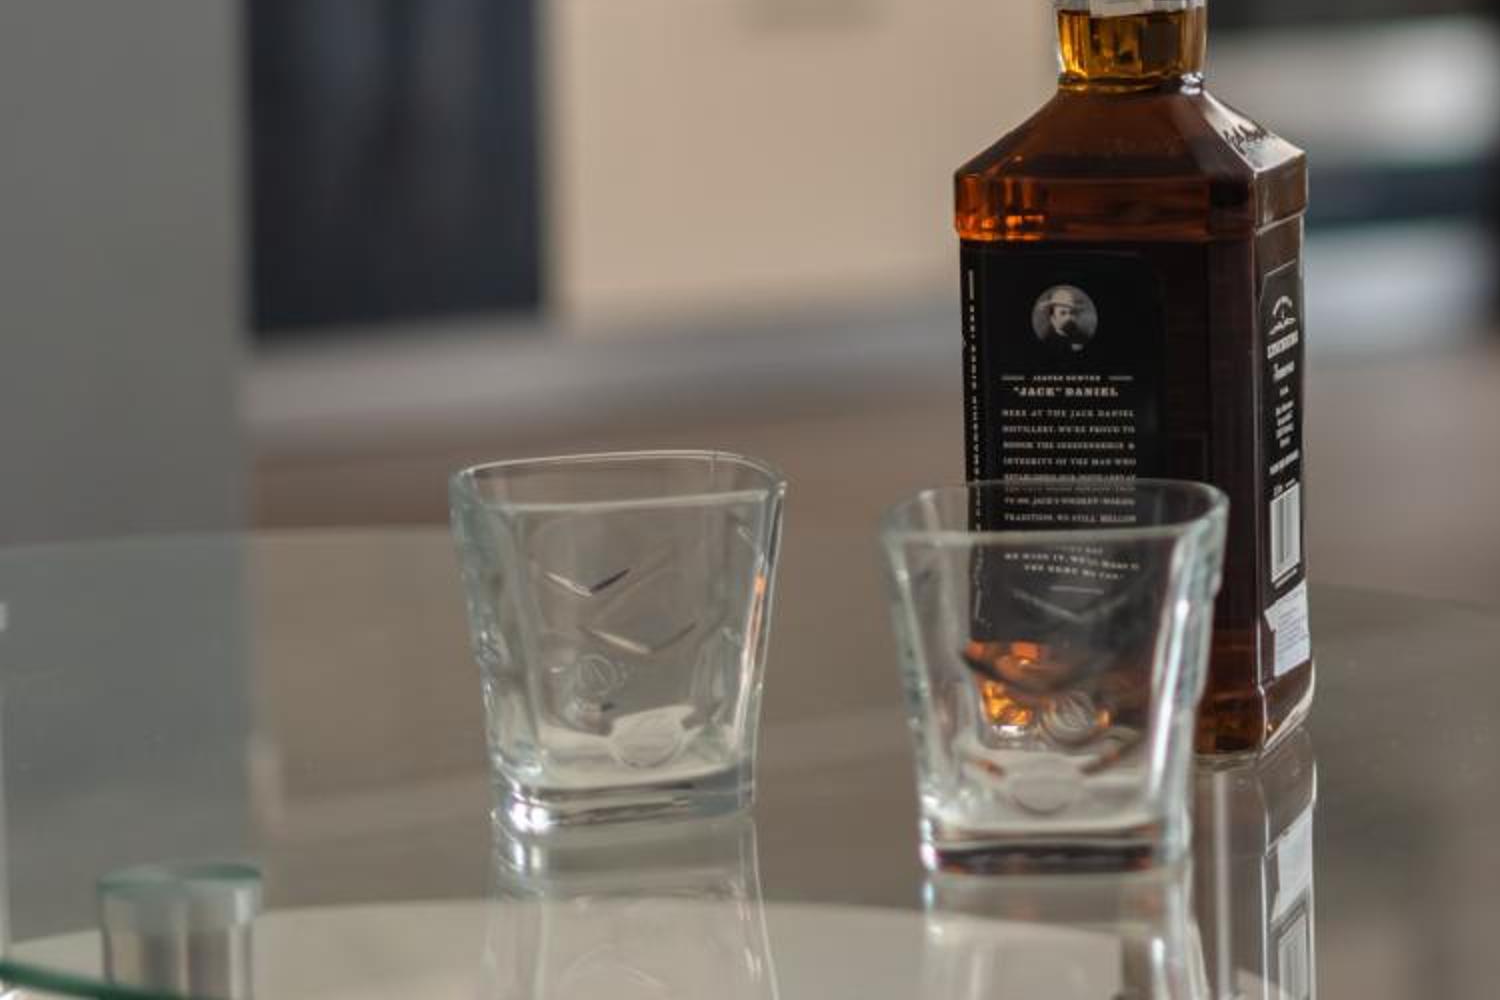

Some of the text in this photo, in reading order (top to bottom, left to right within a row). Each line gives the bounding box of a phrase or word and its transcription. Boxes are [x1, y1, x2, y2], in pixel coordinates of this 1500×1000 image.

[1064, 386, 1119, 397] DANIEL
[1001, 409, 1134, 419] HERE AT THE JACK DANIEL
[1089, 425, 1120, 433] PROUD
[1122, 425, 1135, 433] TO
[1037, 441, 1054, 449] THE
[1071, 457, 1089, 466] THE
